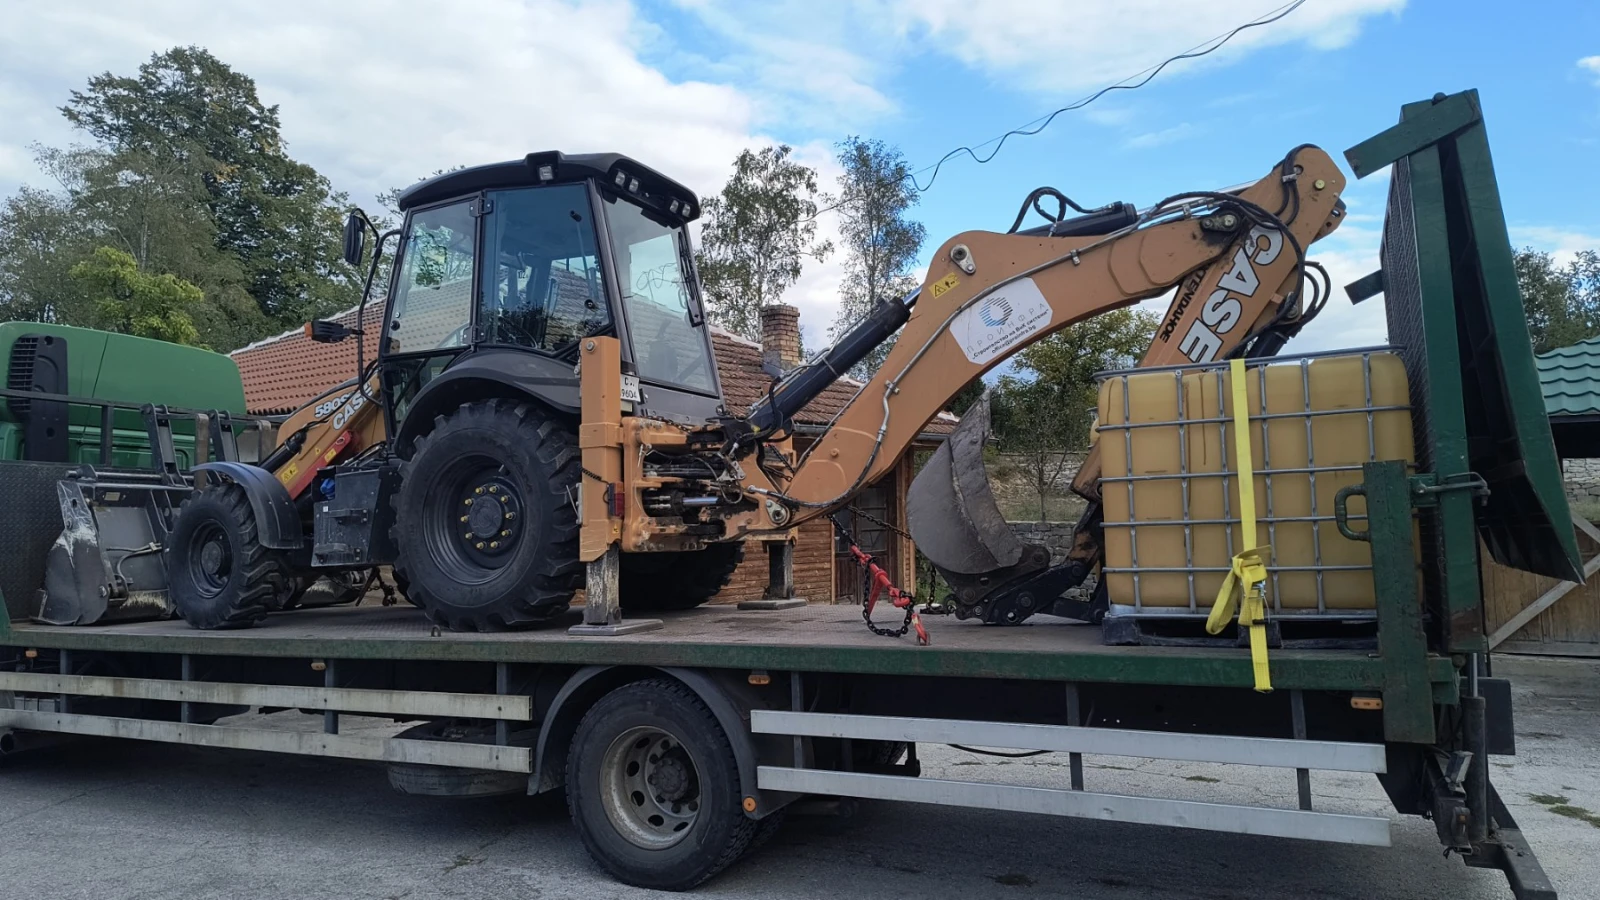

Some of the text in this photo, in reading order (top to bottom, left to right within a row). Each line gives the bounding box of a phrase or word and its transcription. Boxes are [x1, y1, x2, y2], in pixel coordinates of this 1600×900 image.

[1159, 268, 1206, 343] TENDAHOE
[1177, 223, 1284, 369] CASE
[333, 381, 373, 430] CASE
